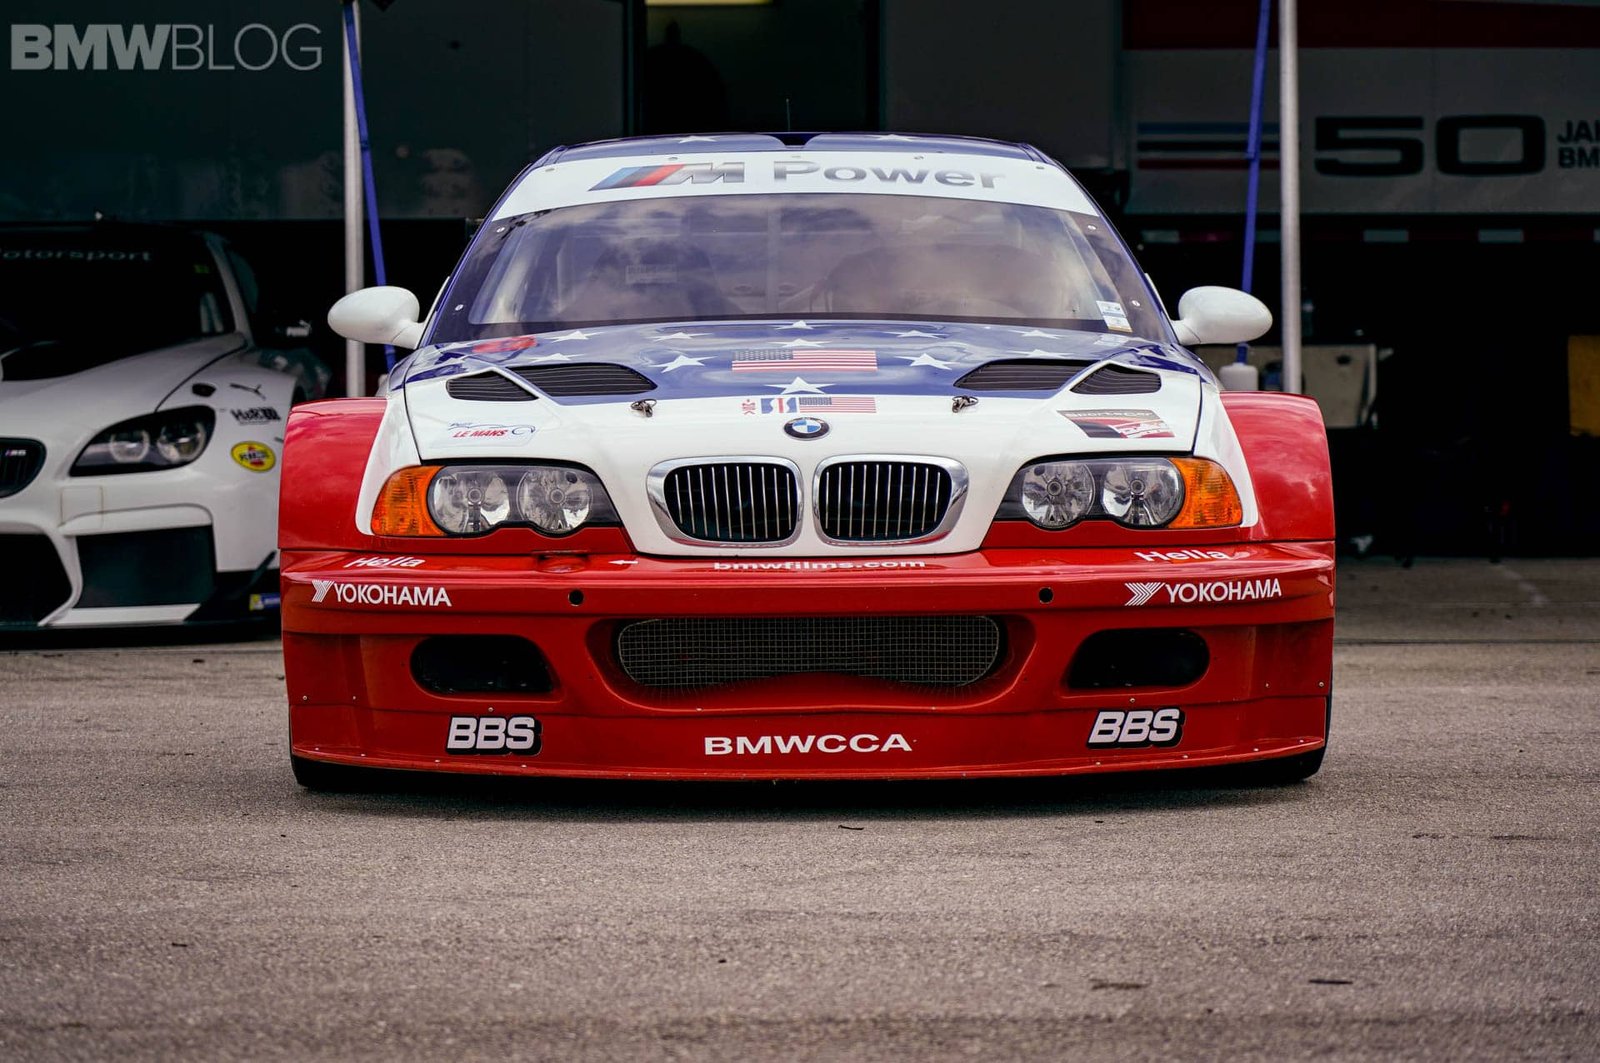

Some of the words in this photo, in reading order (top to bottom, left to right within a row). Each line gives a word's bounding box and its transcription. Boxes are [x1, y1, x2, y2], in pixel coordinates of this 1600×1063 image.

[1557, 120, 1600, 143] JA
[1314, 114, 1546, 177] 50
[773, 160, 1006, 189] Power
[0, 248, 151, 262] otorsport
[470, 429, 508, 437] MANS
[343, 556, 426, 568] Hella
[713, 560, 926, 570] bmwfilms.com
[1134, 549, 1234, 562] Hella
[334, 582, 452, 607] YOKOHAMA
[1165, 578, 1282, 604] YOKOHAMA
[446, 716, 537, 751] BBS
[1087, 708, 1182, 746] BBS
[704, 733, 913, 756] BMWCCA
